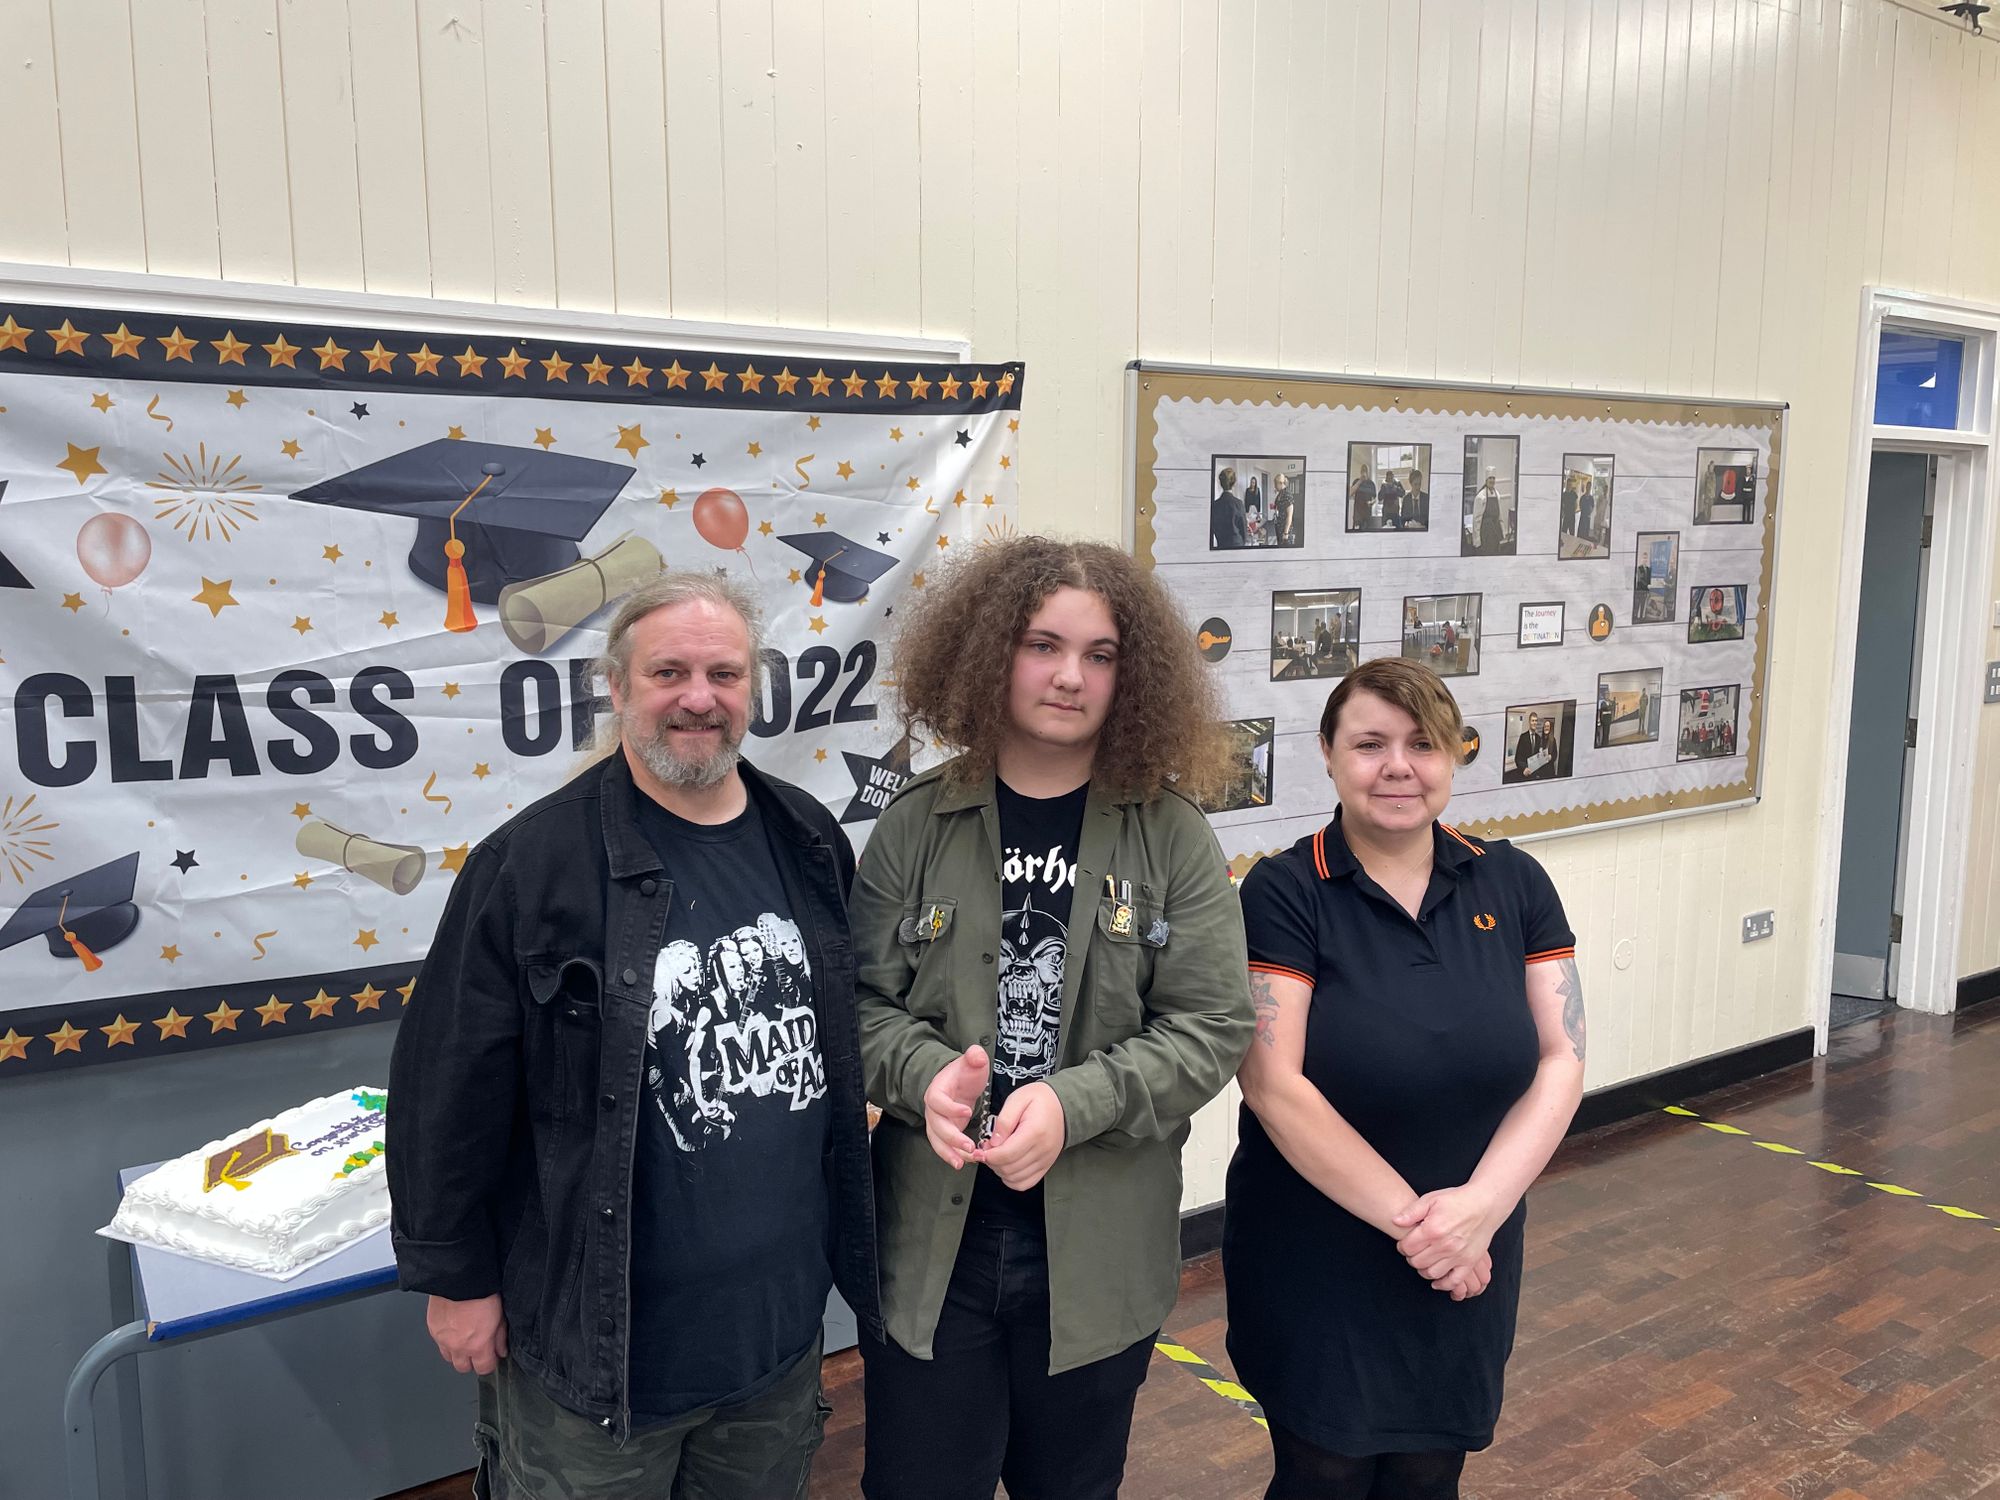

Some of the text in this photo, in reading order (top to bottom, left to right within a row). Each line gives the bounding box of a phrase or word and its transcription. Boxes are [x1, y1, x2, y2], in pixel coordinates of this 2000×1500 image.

[1529, 622, 1538, 630] the
[1535, 609, 1556, 617] Journey
[1523, 632, 1559, 641] DETINATIN
[15, 640, 878, 788] CLASS OF 022
[860, 784, 892, 810] DON
[721, 1013, 815, 1087] MAID
[776, 1057, 800, 1088] OF
